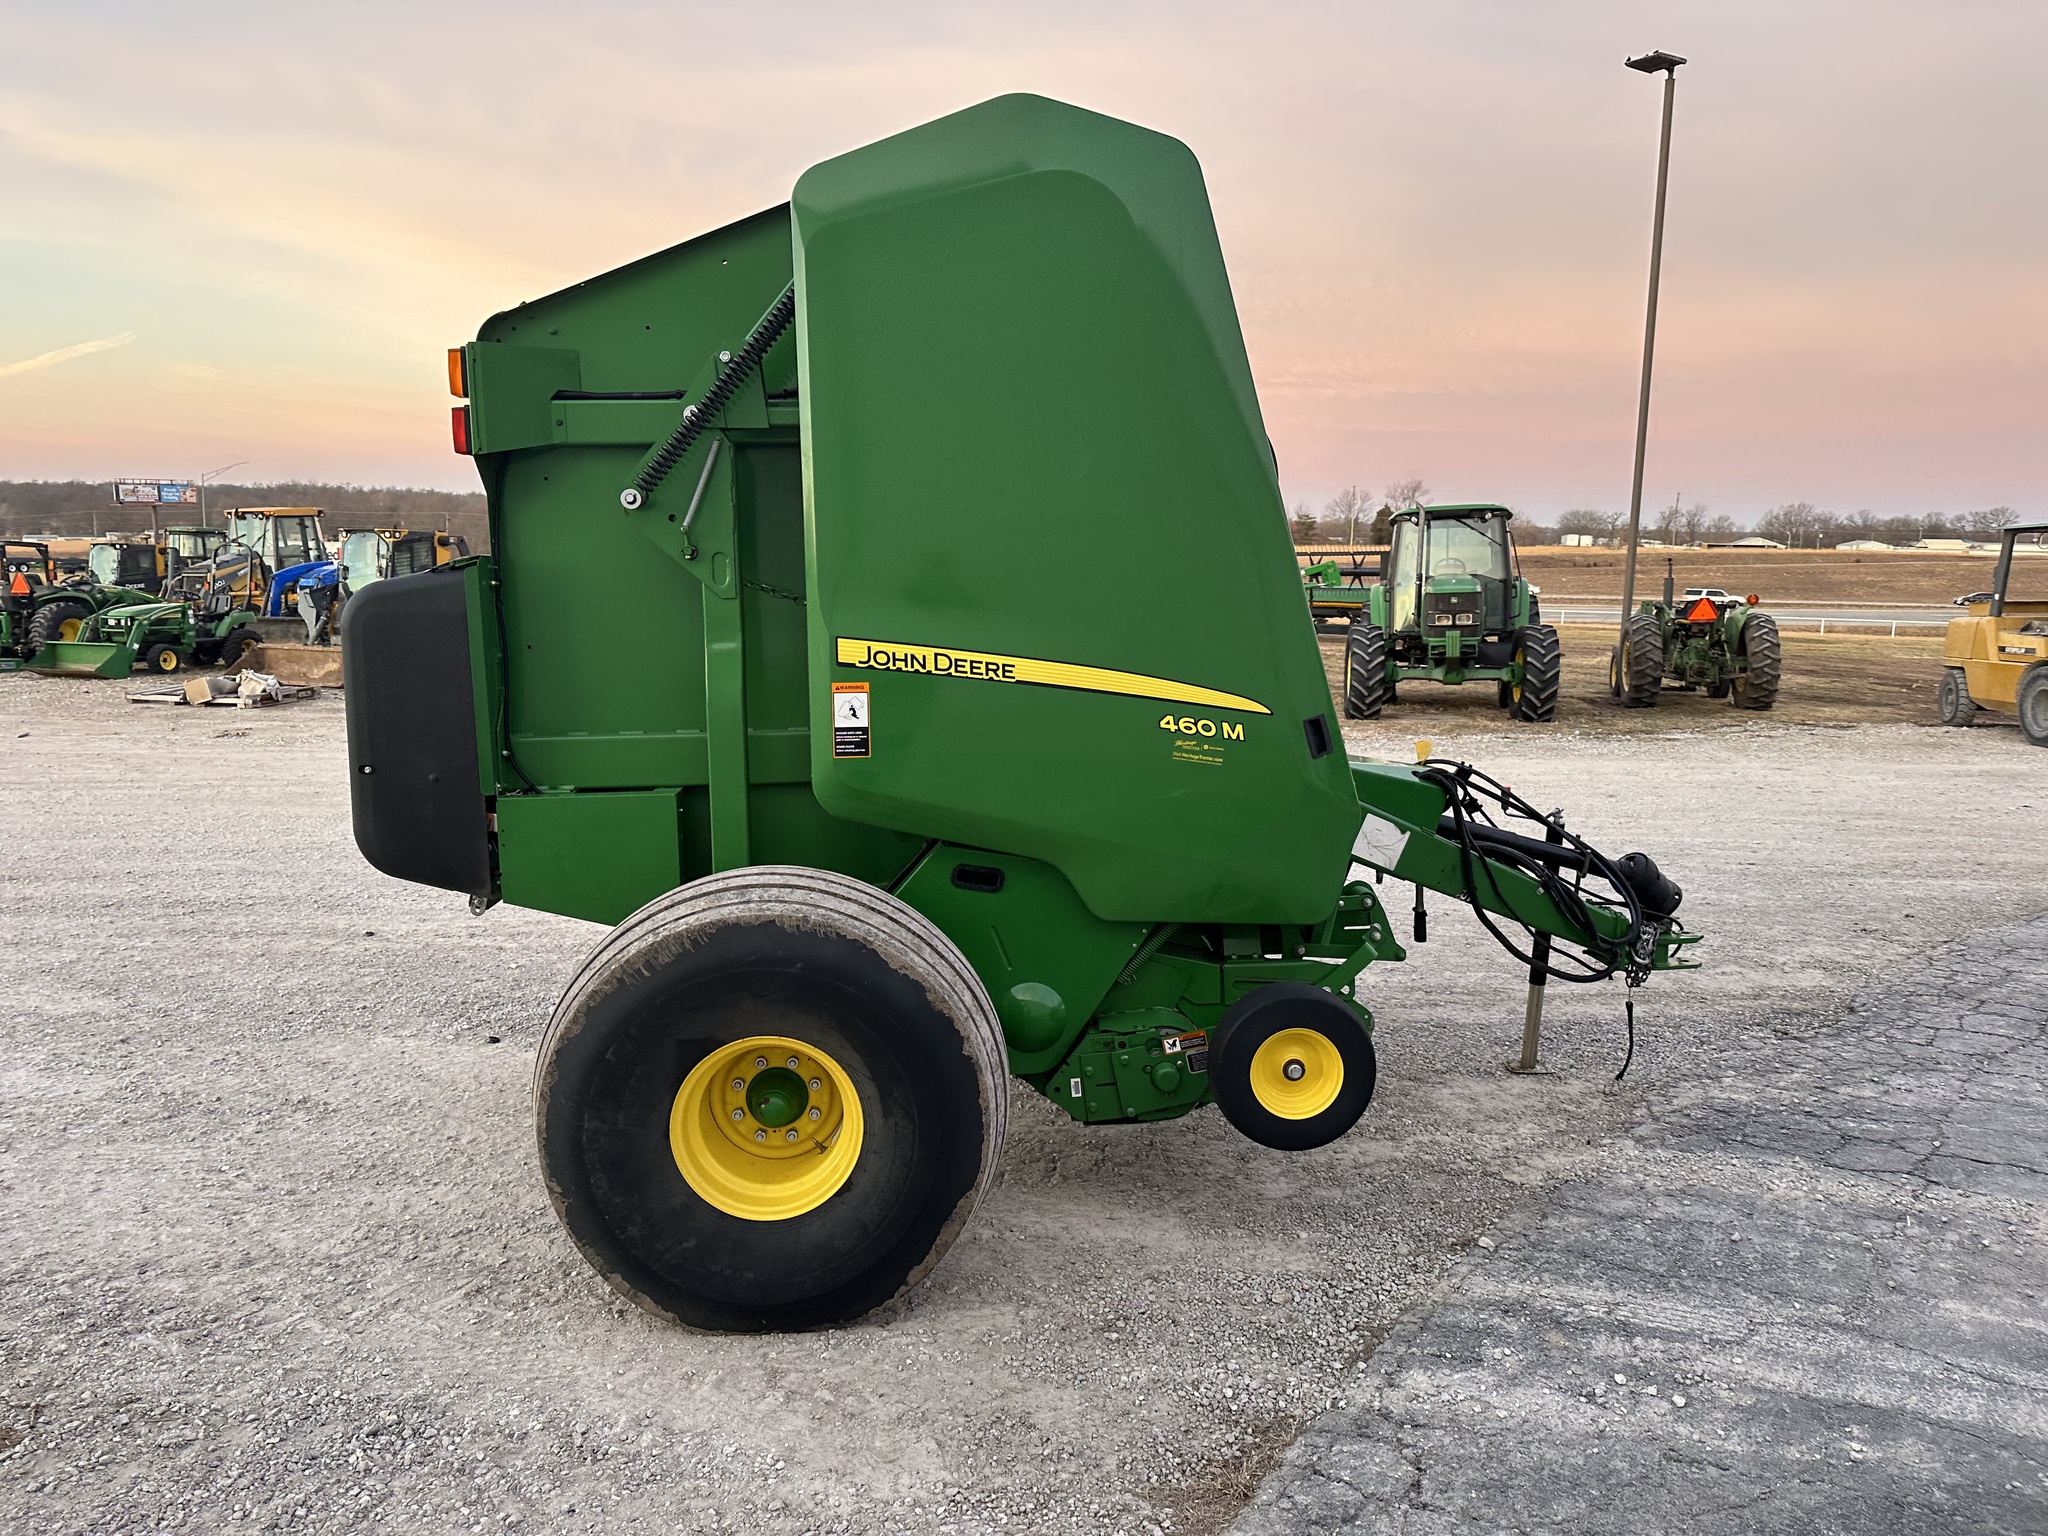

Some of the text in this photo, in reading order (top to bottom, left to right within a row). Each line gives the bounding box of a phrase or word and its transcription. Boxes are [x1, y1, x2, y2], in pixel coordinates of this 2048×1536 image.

[857, 645, 1017, 680] JOHN DEERE
[1159, 713, 1246, 741] 460 M
